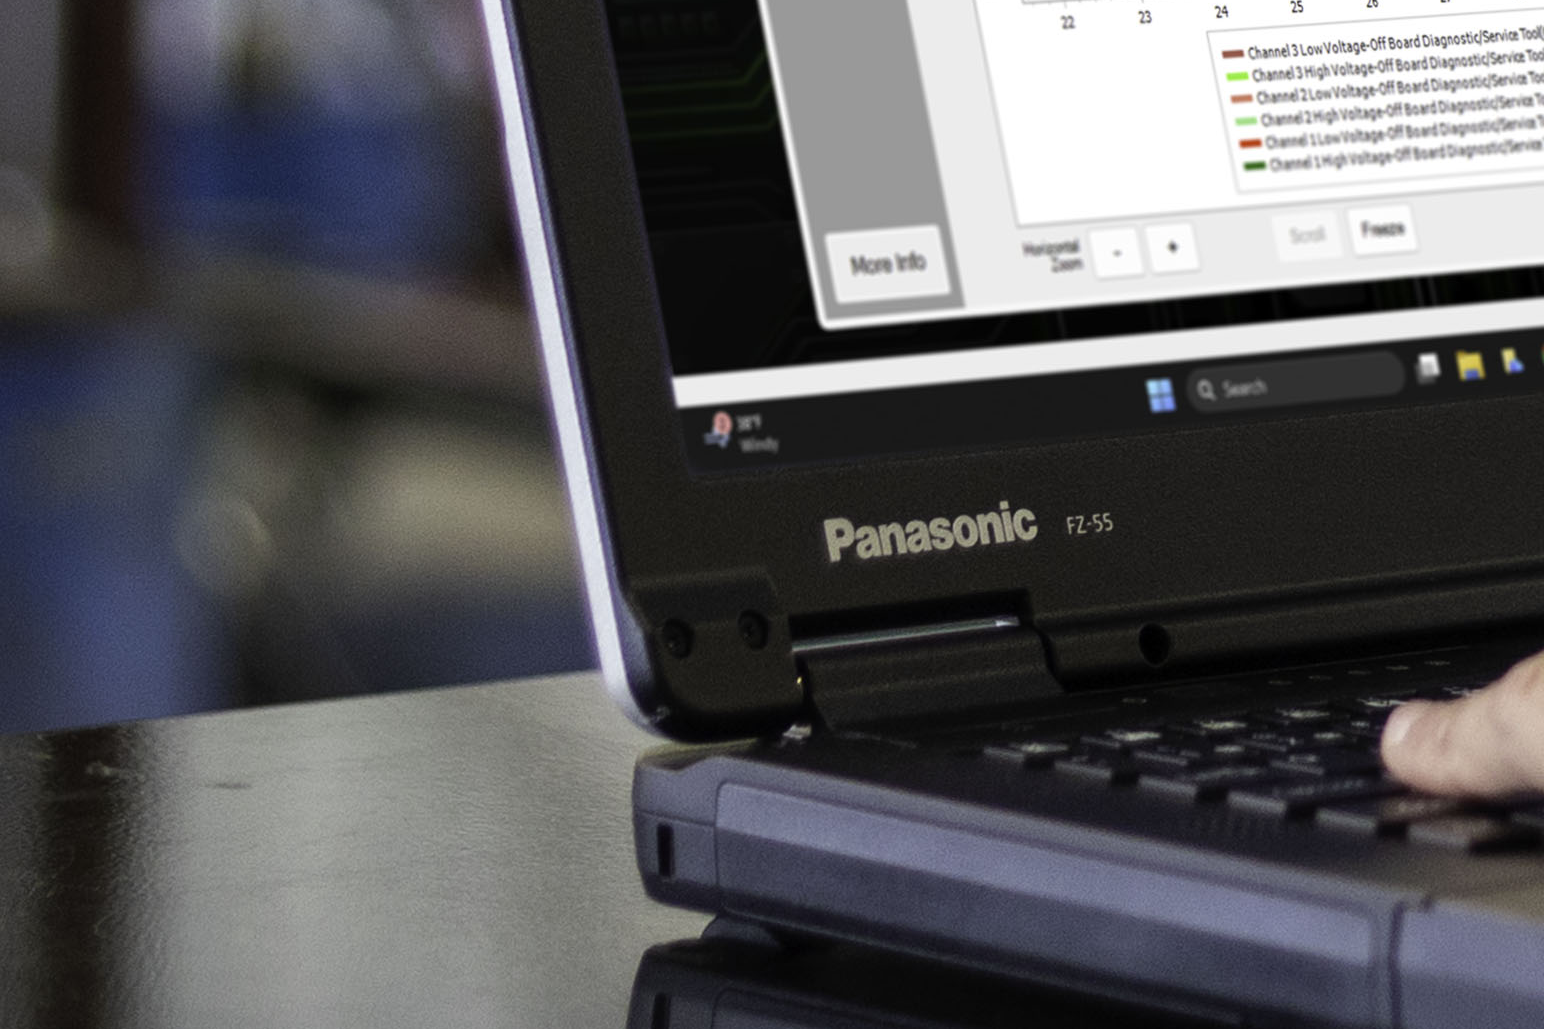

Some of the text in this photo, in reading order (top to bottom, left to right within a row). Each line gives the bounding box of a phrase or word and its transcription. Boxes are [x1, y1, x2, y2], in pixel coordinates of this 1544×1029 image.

[1060, 14, 1076, 31] 22
[1138, 10, 1153, 24] 23
[1215, 4, 1230, 19] 24
[1290, 0, 1305, 15] 25
[1248, 44, 1290, 60] Channel
[1292, 43, 1299, 57] 3
[1300, 43, 1323, 56] Low
[1323, 37, 1386, 55] Voltage-Off
[1388, 35, 1421, 50] Board
[1422, 30, 1519, 49] Diagnostic/Service
[1252, 66, 1295, 82] Channel
[1297, 66, 1303, 79] 3
[1304, 64, 1330, 81] High
[1330, 59, 1394, 77] Voltage-Off
[1395, 56, 1428, 71] Board
[1429, 52, 1526, 71] Diagnostic/Service
[1256, 88, 1299, 105] Channel
[1301, 88, 1308, 101] 2
[1309, 87, 1332, 101] Low
[1332, 81, 1395, 100] Voltage-Off
[1397, 79, 1430, 94] Board
[1431, 74, 1528, 93] Diagnostic/Service
[1260, 110, 1303, 127] Channel
[1305, 110, 1312, 124] 2
[1313, 109, 1339, 126] High
[1339, 103, 1402, 122] Voltage-Off
[1404, 101, 1437, 116] Board
[1438, 95, 1534, 115] Diagnostic/Service
[1265, 132, 1308, 150] Channel
[1310, 132, 1317, 147] 1
[1318, 132, 1340, 146] Low
[1340, 126, 1404, 145] Voltage-Off
[1406, 124, 1438, 139] Board
[1440, 118, 1536, 138] Diagnostic/Service
[1269, 155, 1313, 172] Channel
[1314, 155, 1321, 170] 1
[1322, 154, 1348, 170] High
[1348, 146, 1412, 168] Voltage-Off
[1413, 145, 1445, 161] Board
[1289, 224, 1326, 245] Scroll
[1360, 218, 1405, 238] Freeze
[1022, 239, 1080, 258] Horizontal
[850, 252, 927, 276] More Info
[1050, 256, 1084, 273] Zoom
[1221, 378, 1268, 398] Search
[824, 500, 1038, 562] Panasonic
[1066, 513, 1114, 535] FZ-55
